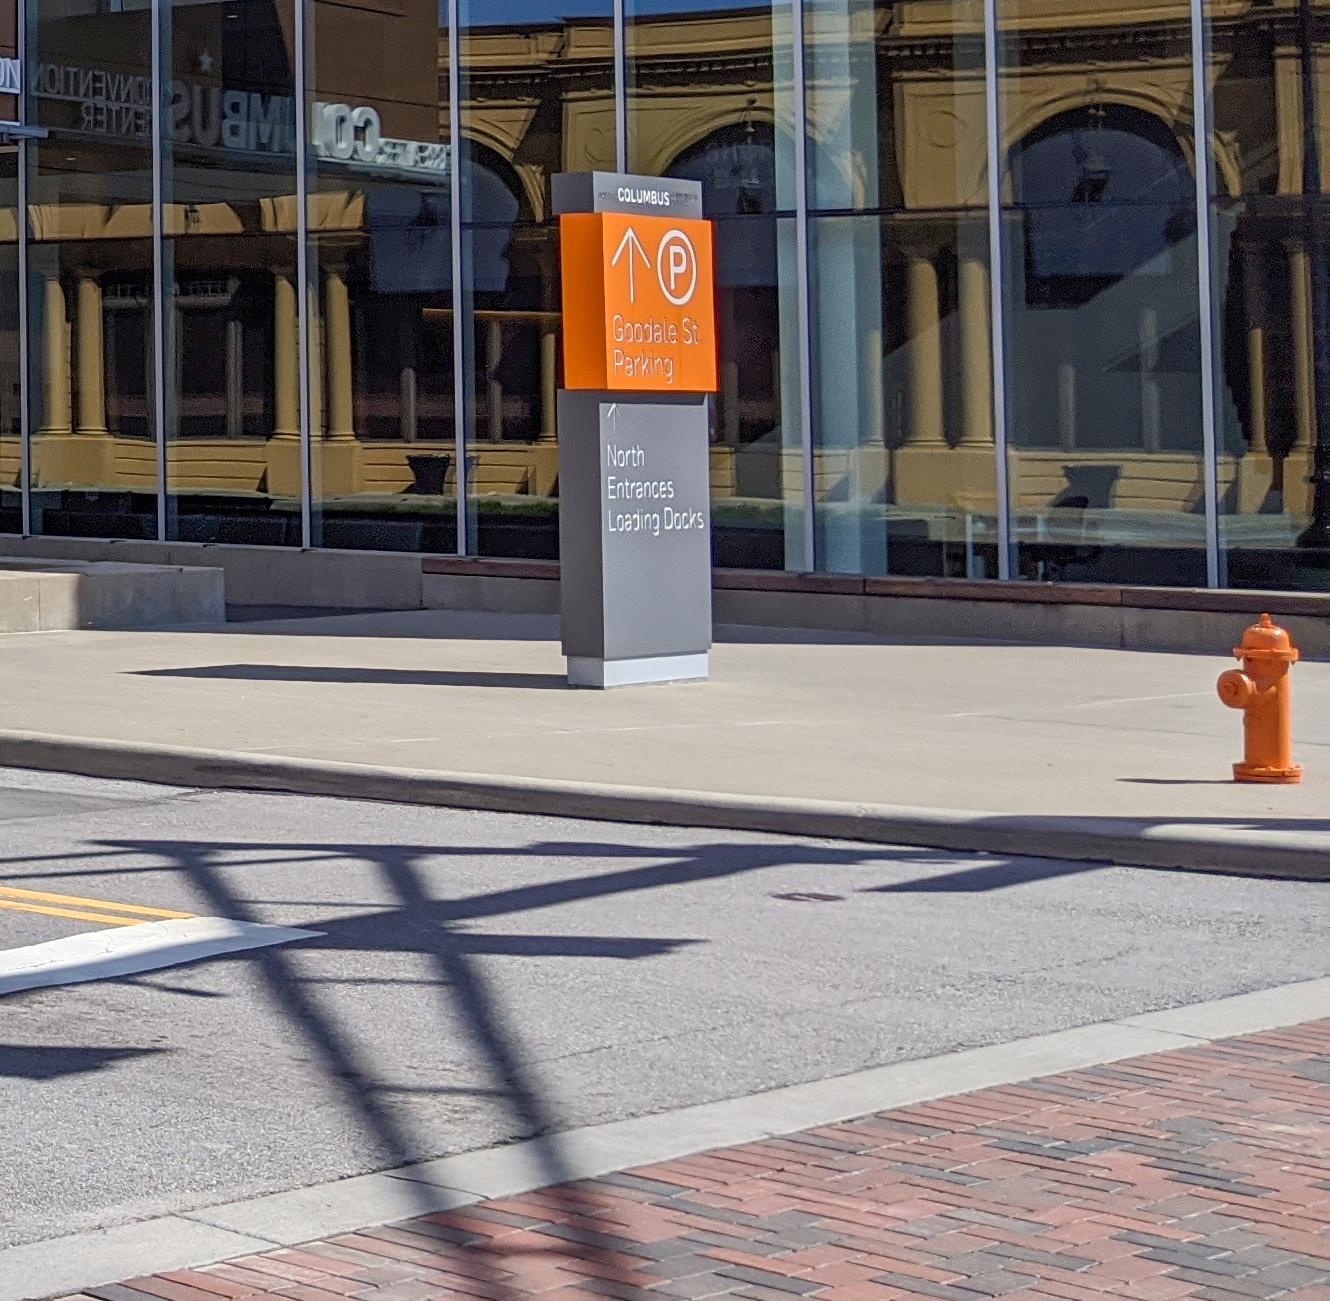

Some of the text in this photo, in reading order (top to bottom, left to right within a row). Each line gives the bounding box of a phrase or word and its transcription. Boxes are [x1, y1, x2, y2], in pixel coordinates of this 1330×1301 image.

[617, 187, 670, 207] COLUMBUS
[669, 245, 687, 290] P
[612, 314, 678, 345] Goodale
[613, 348, 675, 385] Parking
[607, 444, 645, 467] North
[607, 476, 675, 499] Entrances
[608, 506, 705, 536] Loading Docks
